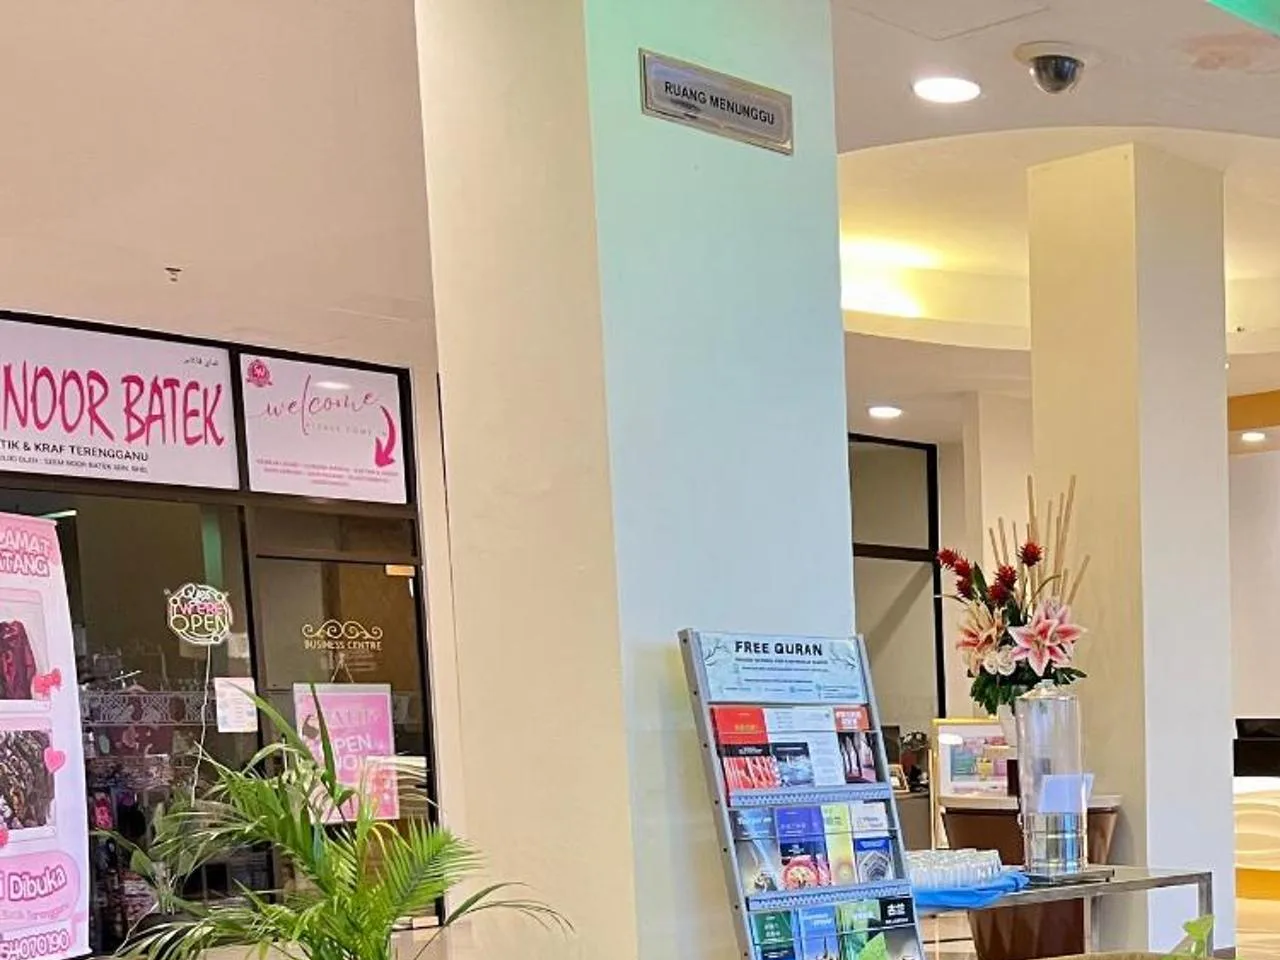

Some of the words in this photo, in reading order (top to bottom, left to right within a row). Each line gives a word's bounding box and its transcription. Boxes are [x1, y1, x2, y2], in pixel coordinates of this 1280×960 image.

[664, 81, 707, 105] RUANG
[709, 95, 775, 125] MENUNGGU
[2, 359, 115, 442] NOOR
[121, 373, 226, 448] BATEK
[254, 374, 378, 436] welcome
[23, 442, 31, 451] &
[34, 442, 66, 454] KRAF
[69, 445, 150, 462] TERENGGANU
[170, 614, 228, 632] OPEN
[304, 639, 345, 649] BUSINESS
[347, 640, 383, 651] CENTRE
[735, 641, 770, 654] FREE
[774, 643, 823, 656] QURAN
[8, 864, 67, 901] Dibuka
